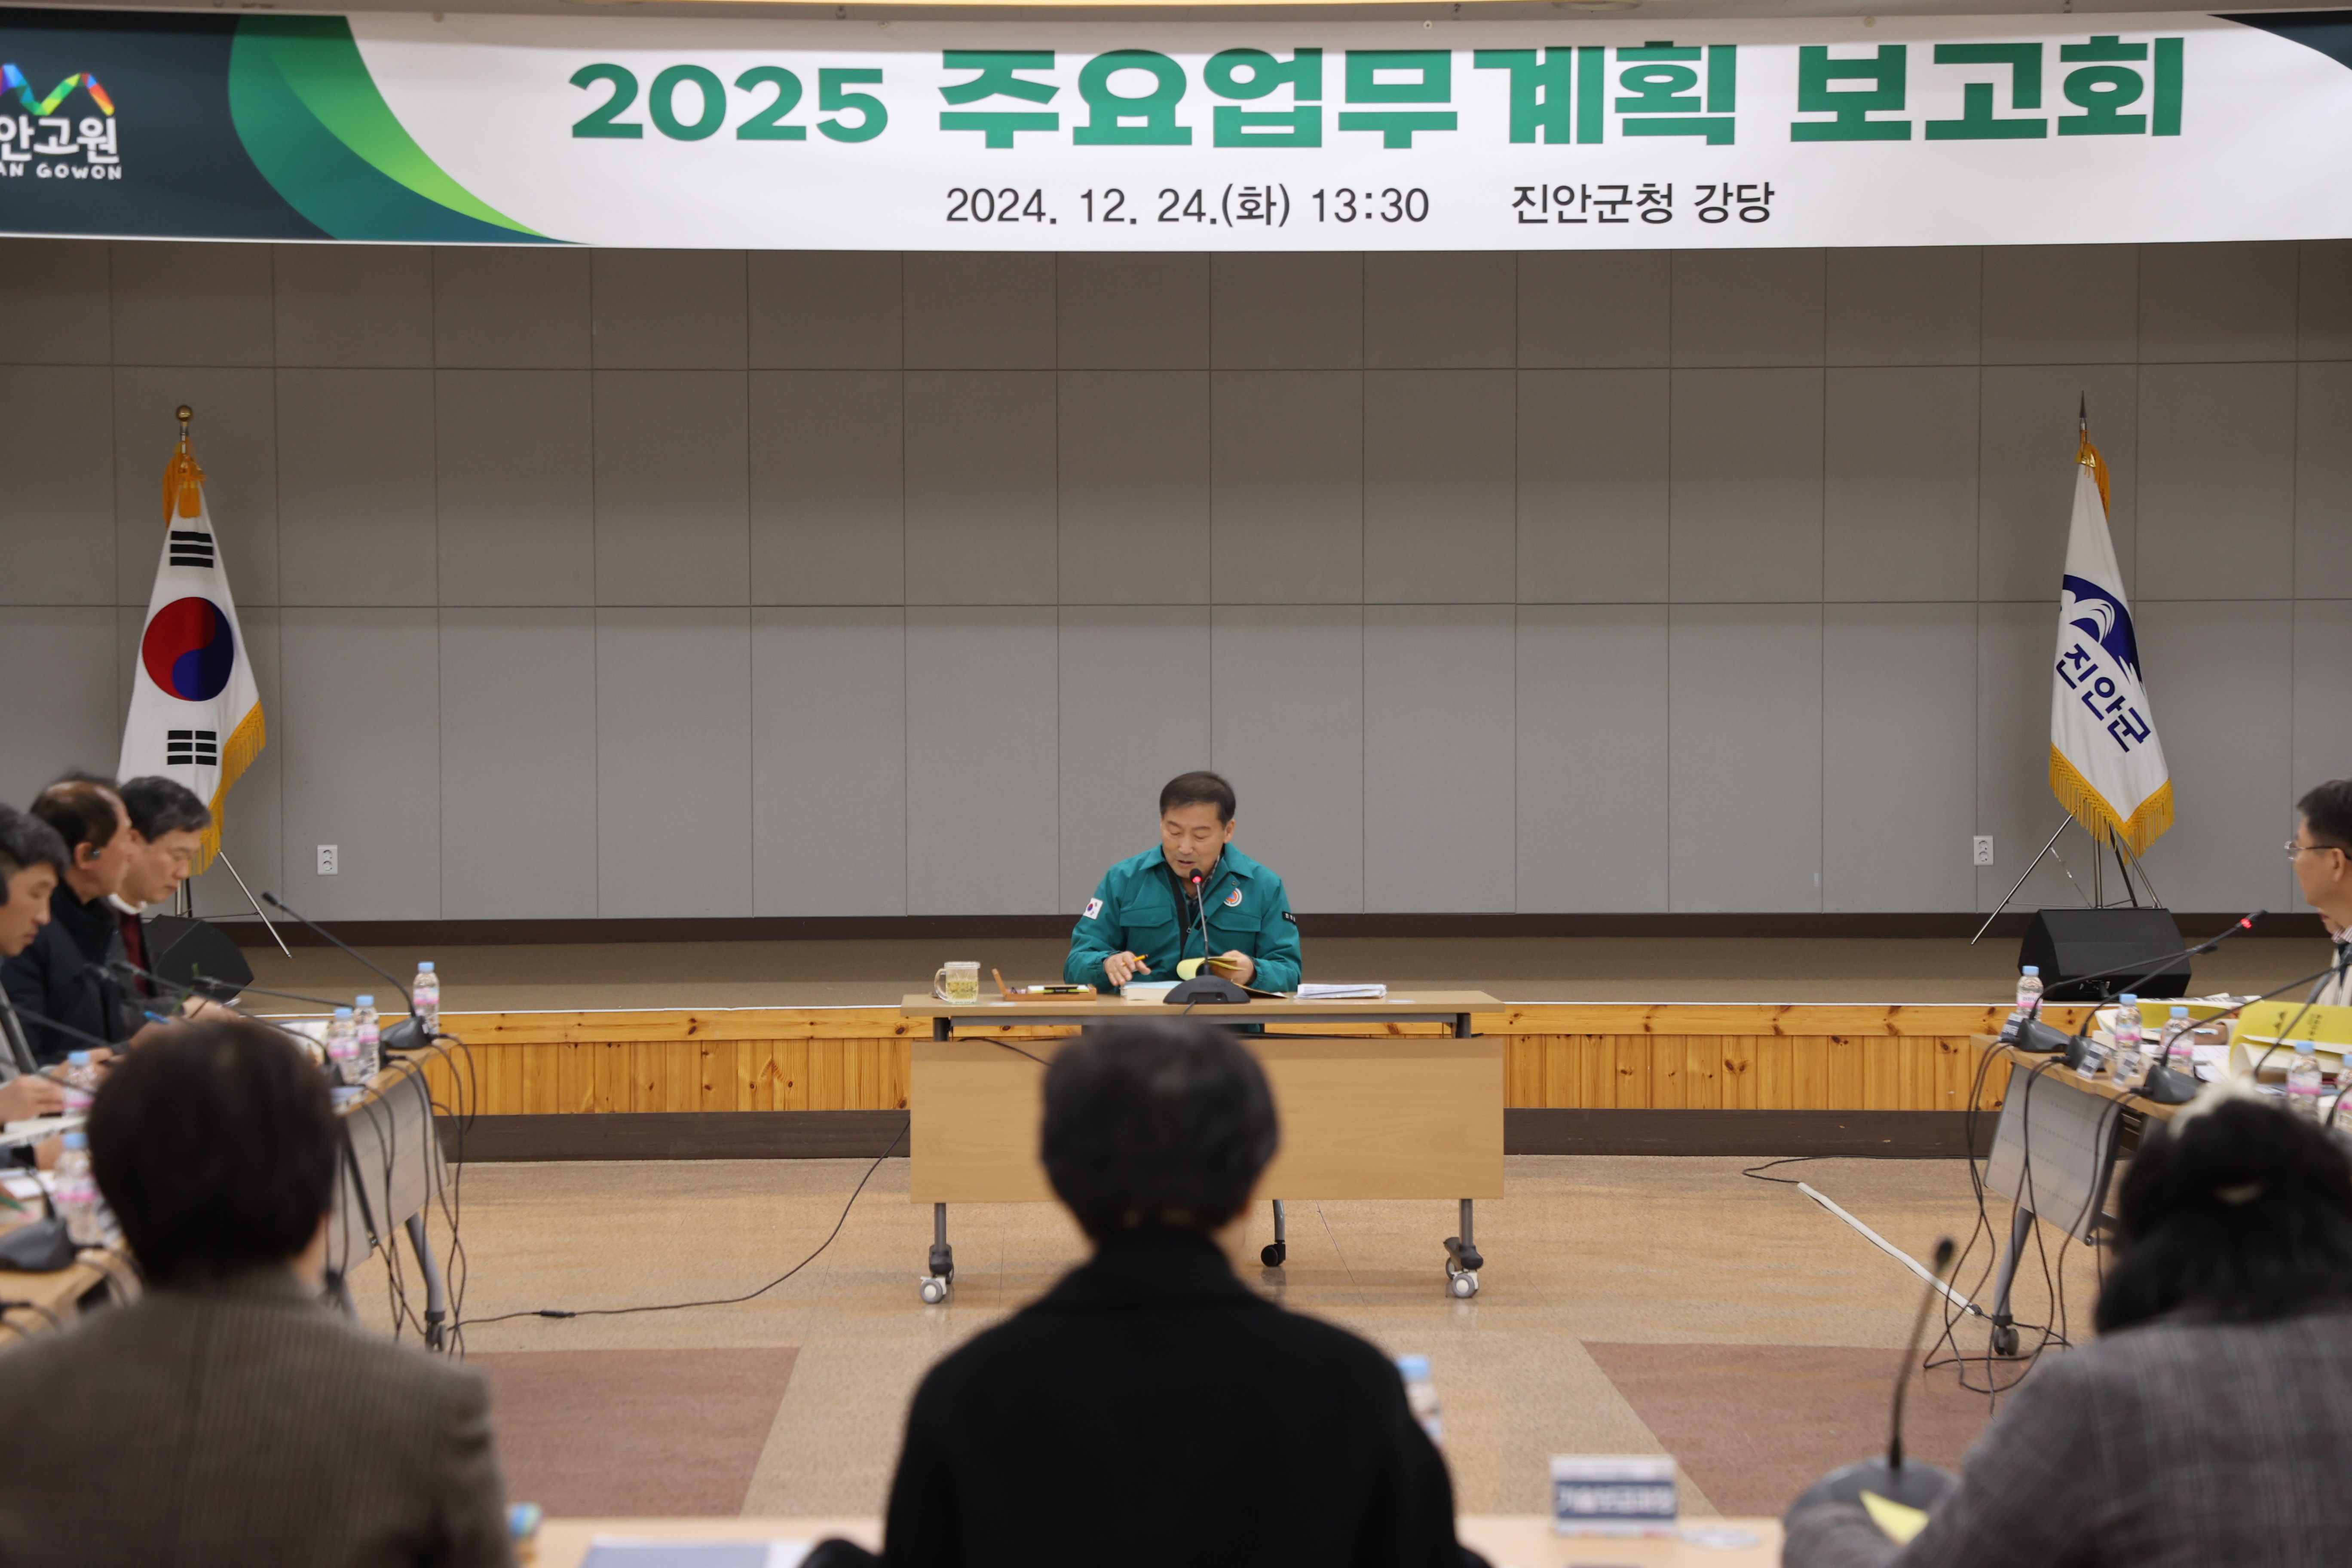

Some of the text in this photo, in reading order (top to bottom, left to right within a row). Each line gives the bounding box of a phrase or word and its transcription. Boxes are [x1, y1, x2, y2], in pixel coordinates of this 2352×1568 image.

[569, 35, 2184, 149] 2025 주요업무계획 보고회
[36, 162, 122, 180] GOWON
[946, 181, 1775, 228] 2024. 12. 24.(화) 13:30 진안군청 강당
[2056, 643, 2151, 753] 진안군
